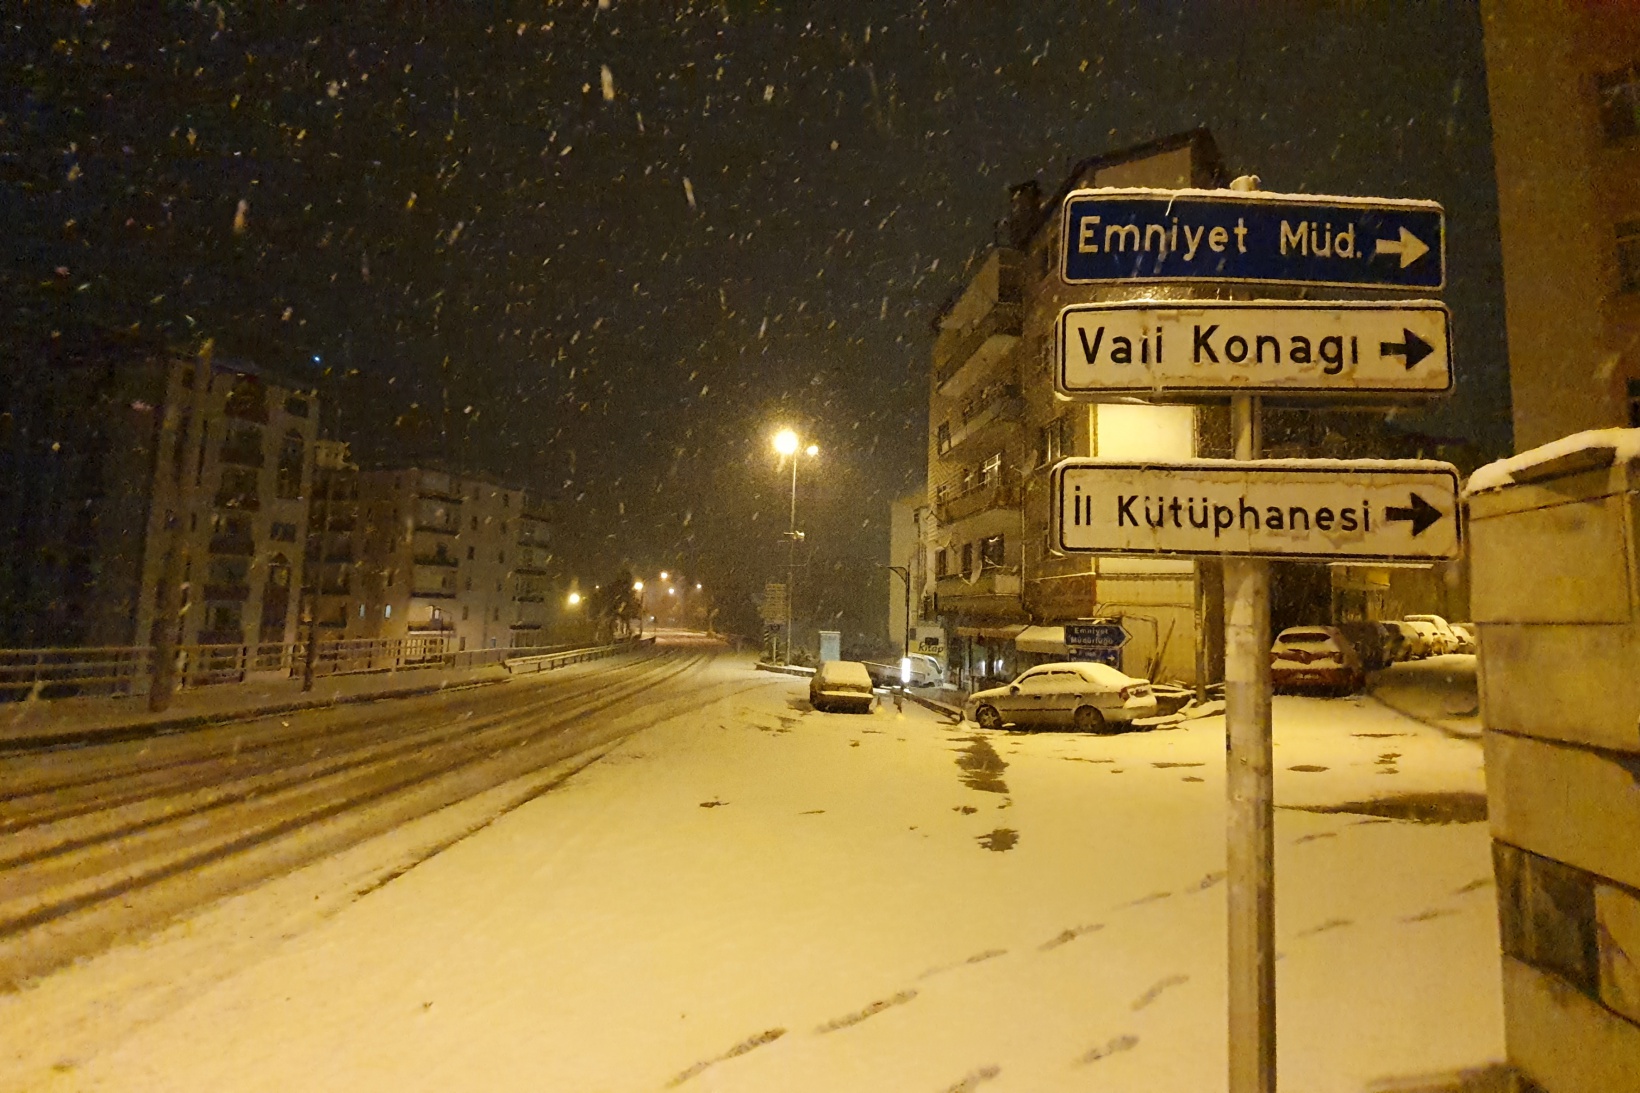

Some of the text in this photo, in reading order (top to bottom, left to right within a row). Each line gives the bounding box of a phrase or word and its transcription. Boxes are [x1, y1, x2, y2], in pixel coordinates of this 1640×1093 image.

[1078, 216, 1363, 261] Emniyet Müd.
[1118, 494, 1371, 538] Kütüphanesi
